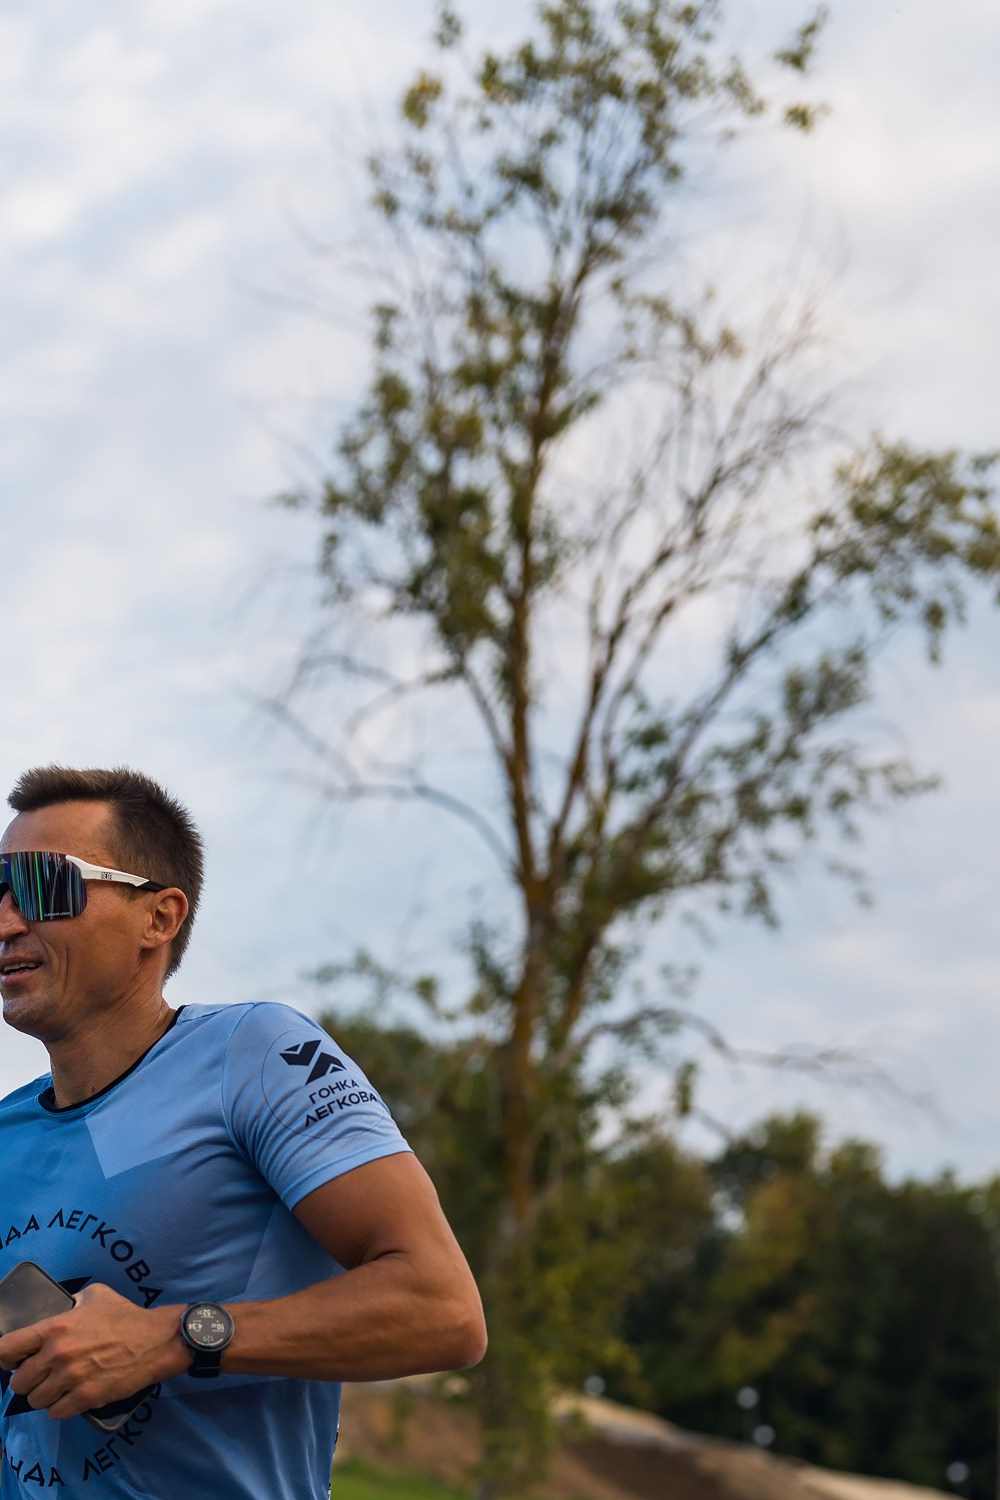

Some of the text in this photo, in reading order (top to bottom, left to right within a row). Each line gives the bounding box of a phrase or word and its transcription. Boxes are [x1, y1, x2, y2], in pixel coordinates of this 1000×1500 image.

[305, 1091, 377, 1127] ЛЕГКОВА
[309, 1079, 359, 1104] ГОНКА
[47, 1208, 163, 1309] ЛЕГКОВА
[82, 1382, 162, 1482] ЛЕГКО
